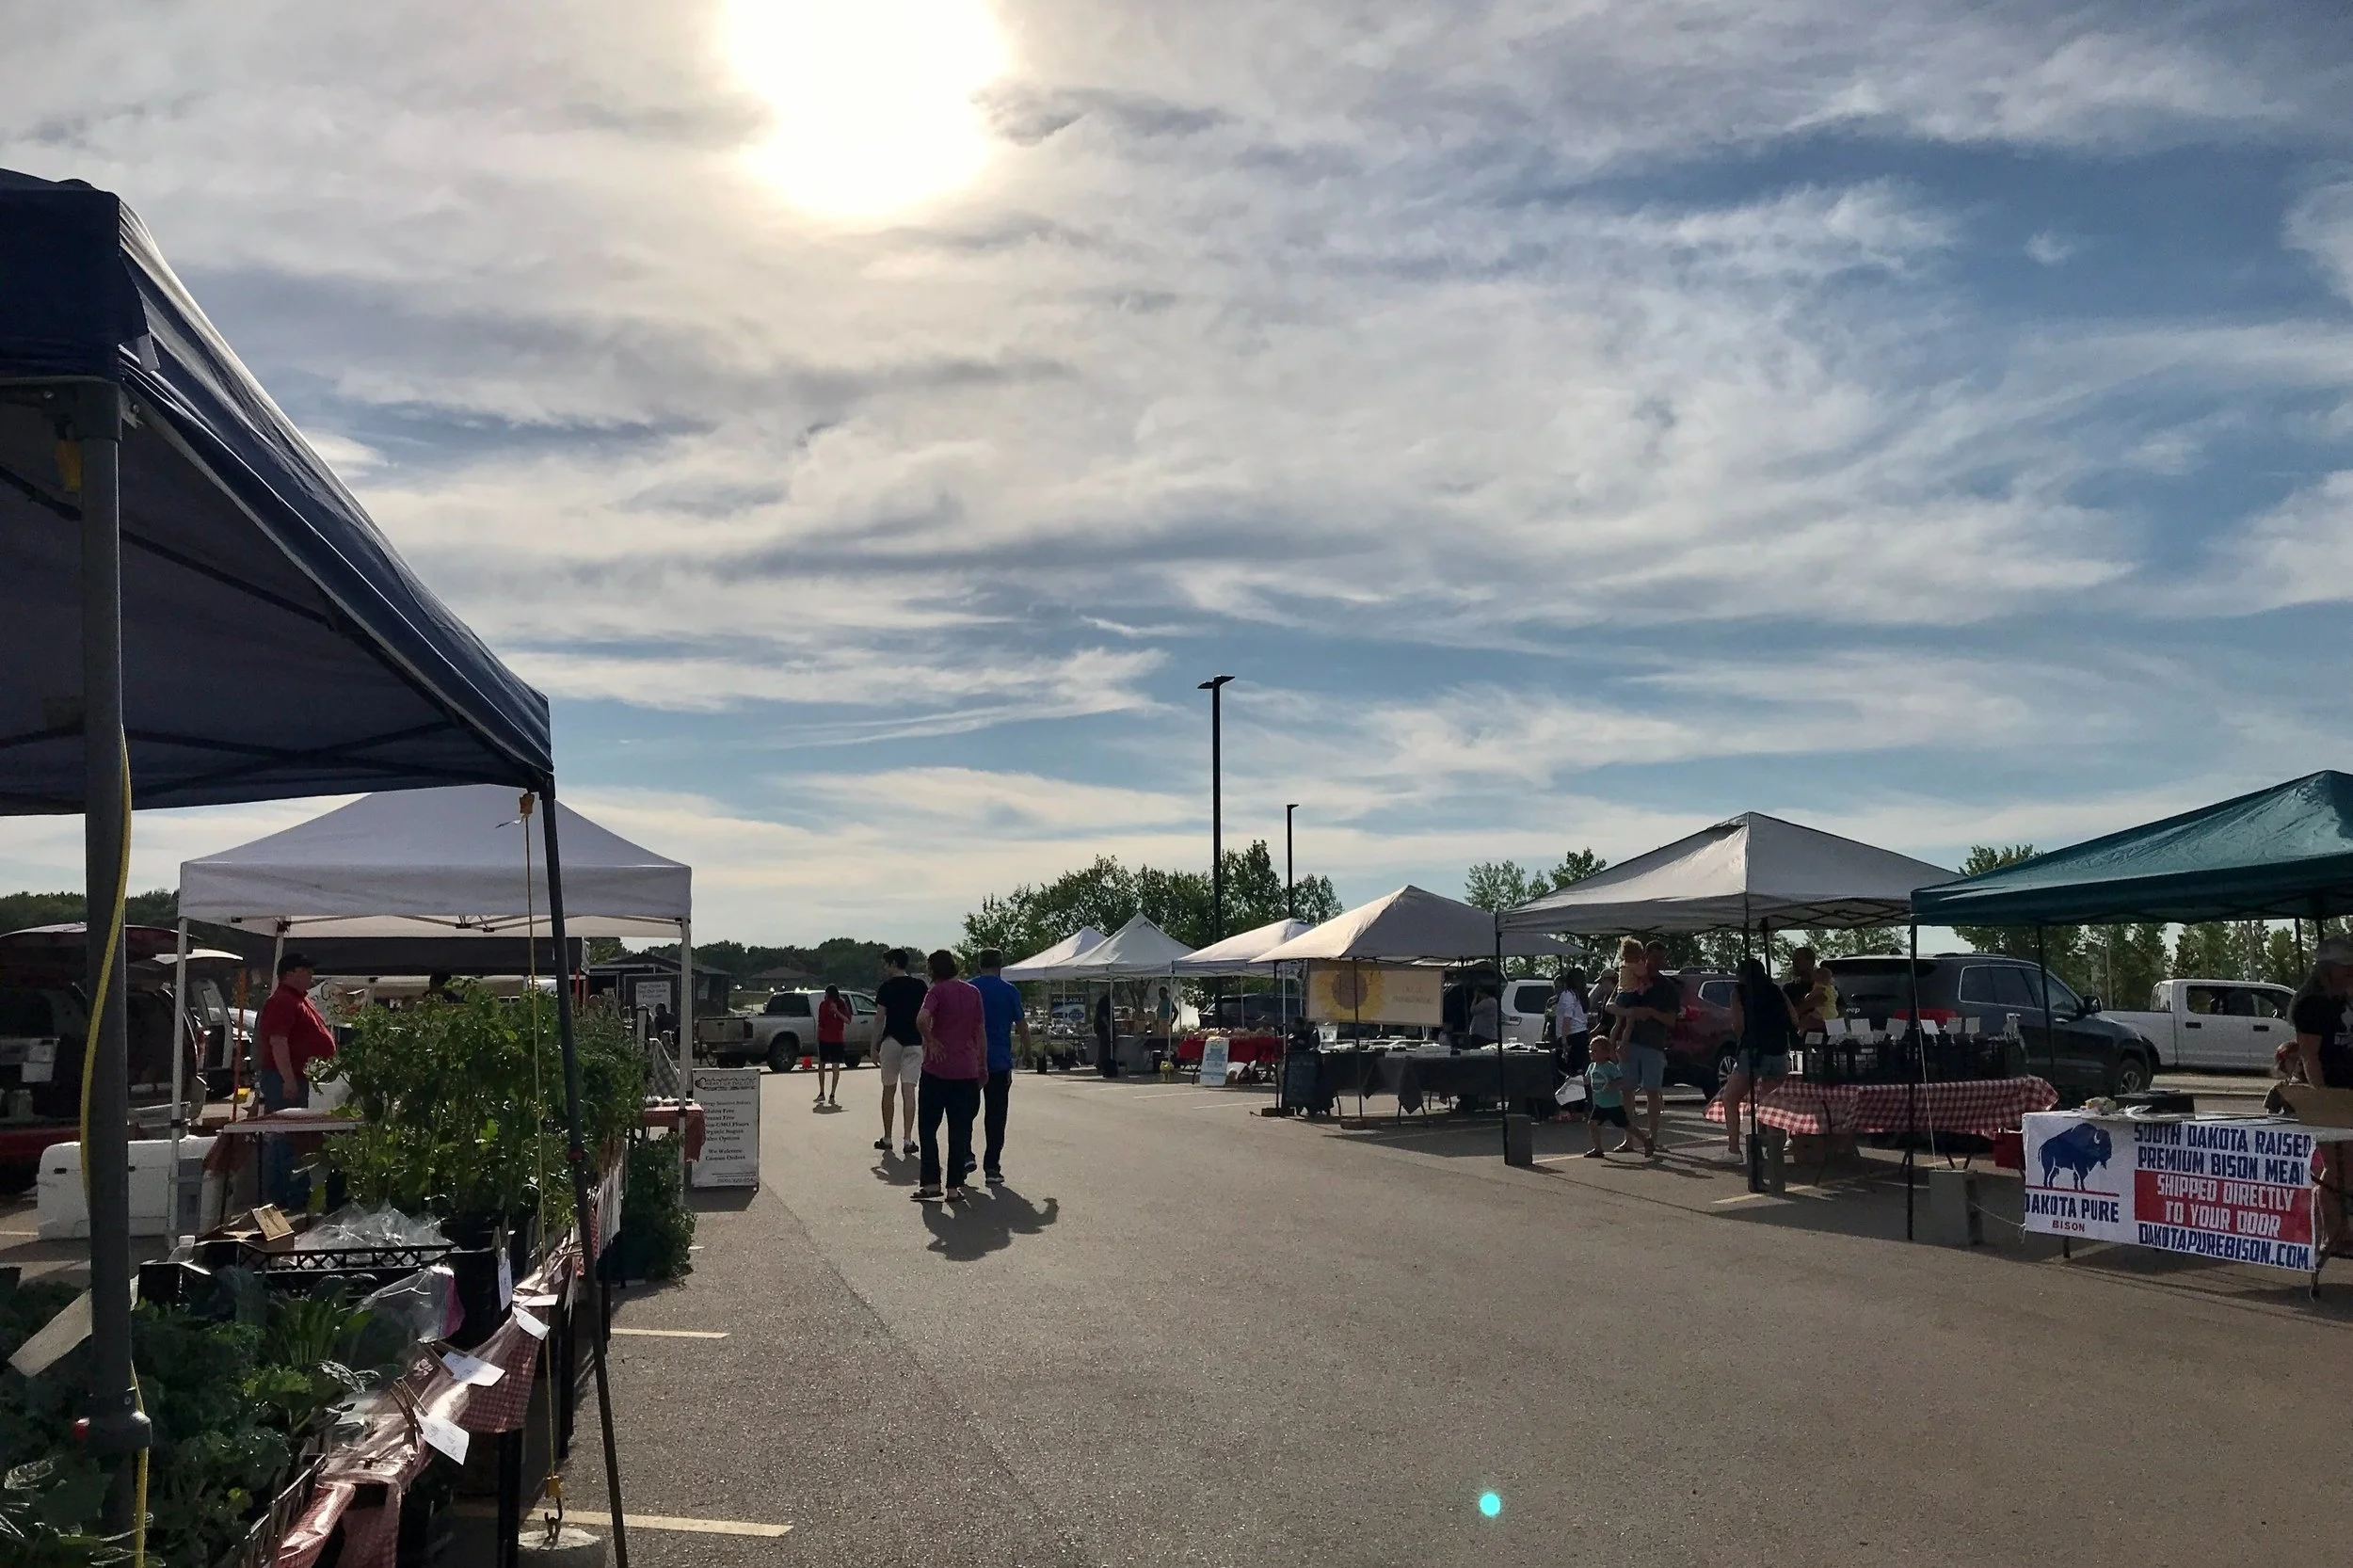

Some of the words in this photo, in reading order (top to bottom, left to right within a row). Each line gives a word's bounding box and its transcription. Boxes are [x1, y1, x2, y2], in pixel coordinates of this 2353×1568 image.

[2134, 1122, 2182, 1146] SOUTH
[2187, 1125, 2249, 1153] DAKOTA
[2255, 1130, 2312, 1159] RAISED
[2137, 1145, 2204, 1175] PREMIUM
[2210, 1153, 2258, 1180] BISON
[2081, 1198, 2120, 1224] PURE
[2156, 1174, 2217, 1202] SHIPPED
[2222, 1181, 2295, 1212] DIRECTLY
[2052, 1220, 2086, 1233] BISON
[2165, 1200, 2185, 1224] TO
[2189, 1204, 2231, 1231] YOUR
[2236, 1209, 2281, 1238] DOOR
[2138, 1223, 2310, 1271] DAKOTAPUREBISON.COM
